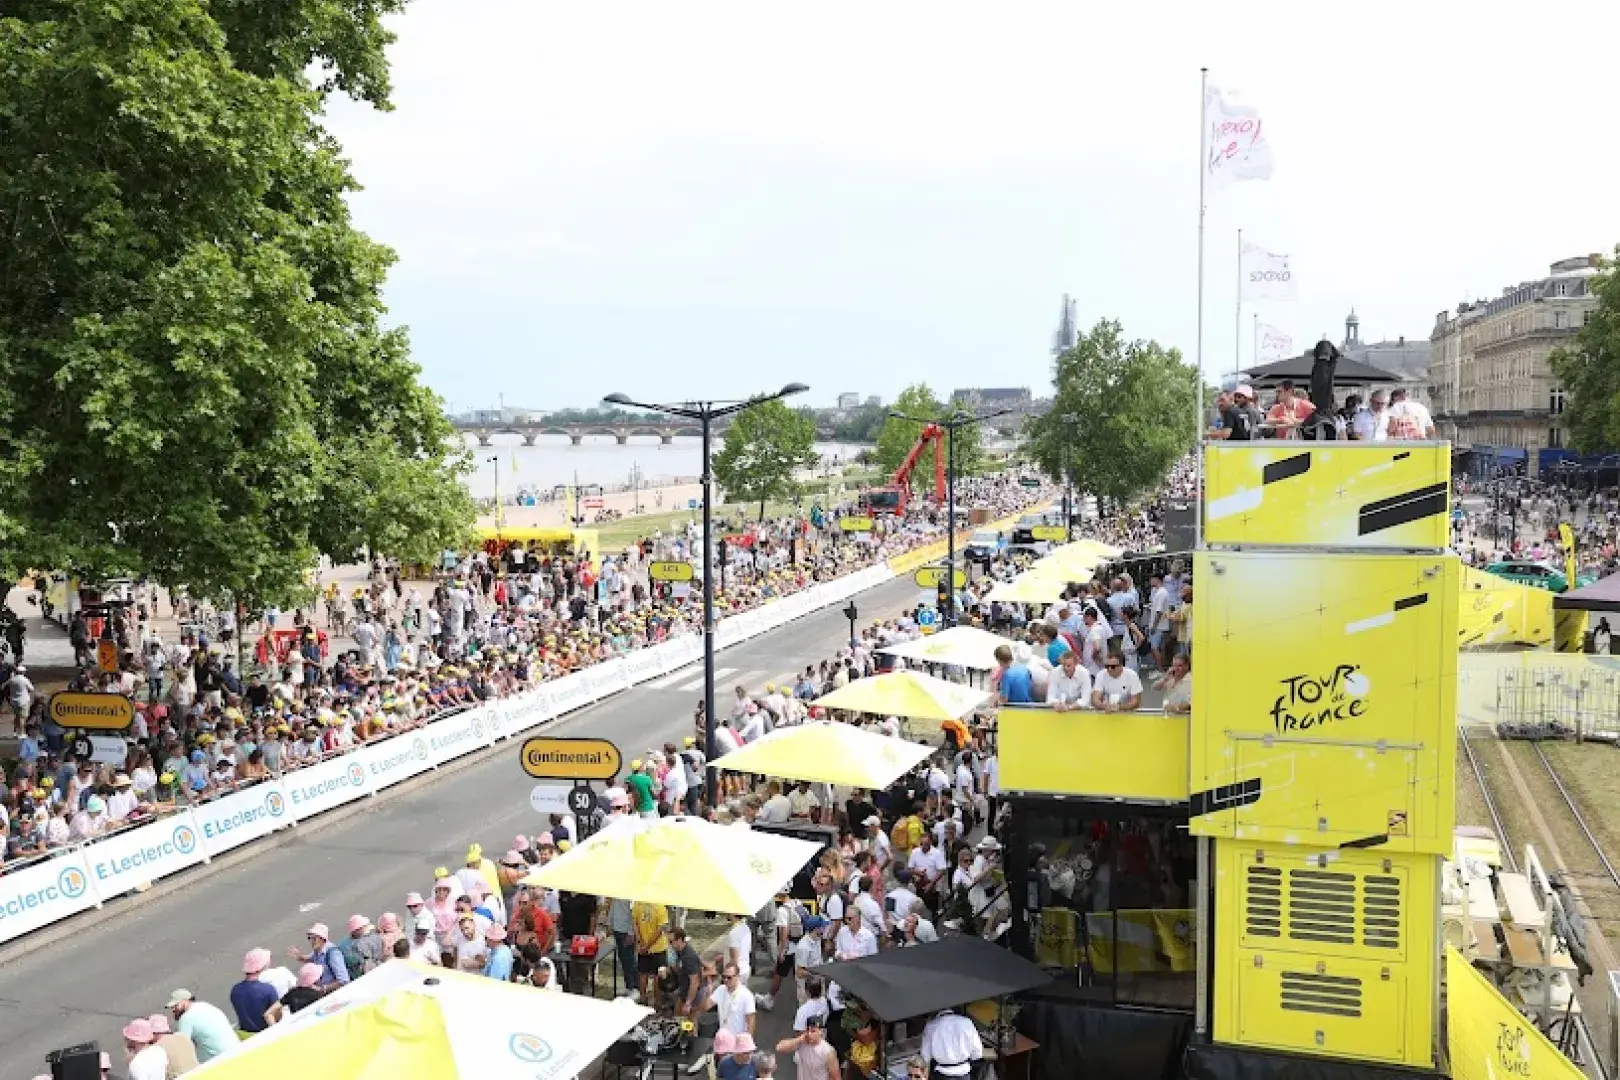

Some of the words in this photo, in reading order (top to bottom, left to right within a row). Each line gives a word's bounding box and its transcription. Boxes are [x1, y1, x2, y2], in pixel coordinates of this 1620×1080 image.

[55, 702, 118, 717] Continental
[528, 749, 601, 767] Continental
[575, 793, 590, 809] 50
